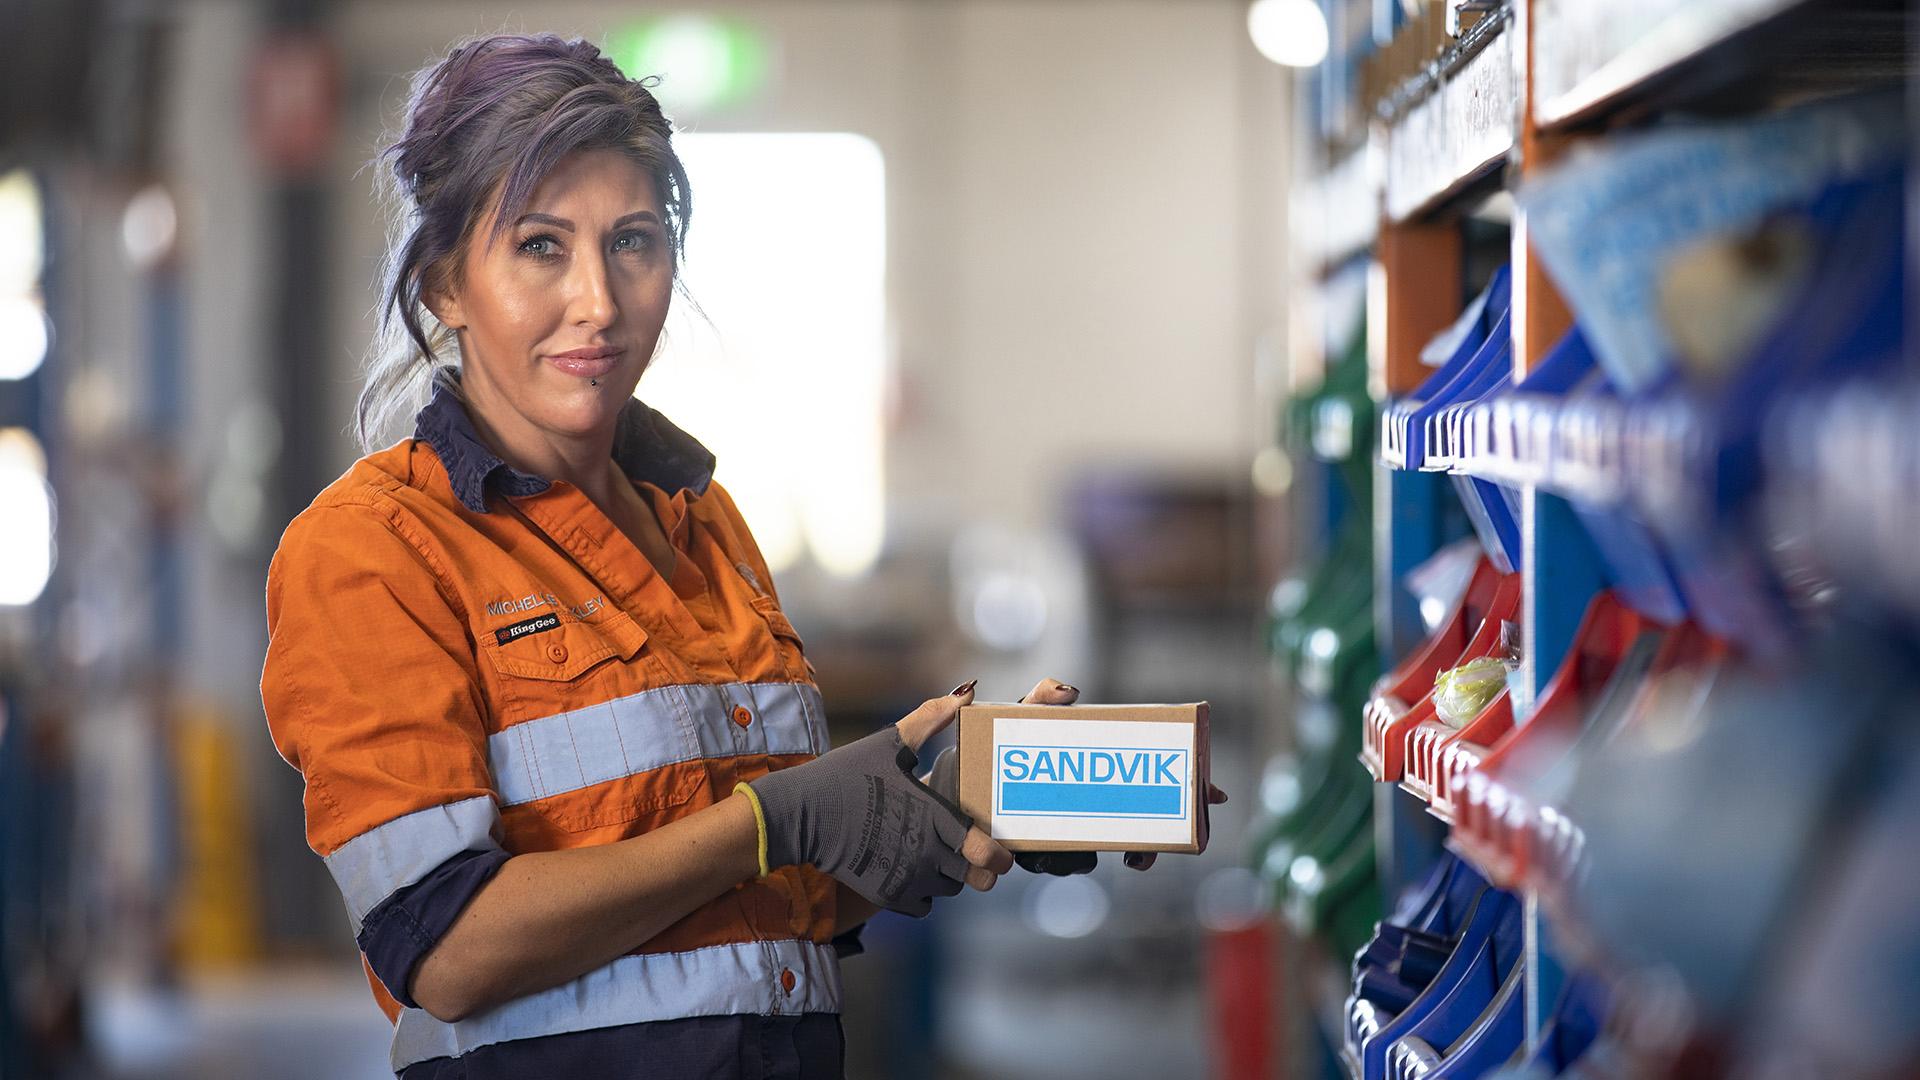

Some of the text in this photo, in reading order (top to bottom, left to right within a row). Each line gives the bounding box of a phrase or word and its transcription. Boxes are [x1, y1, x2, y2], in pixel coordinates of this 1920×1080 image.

[486, 593, 559, 617] MICHELLE
[510, 617, 557, 637] KingGee
[1003, 750, 1181, 784] SANDVIK
[847, 773, 875, 870] prosafetygear.com
